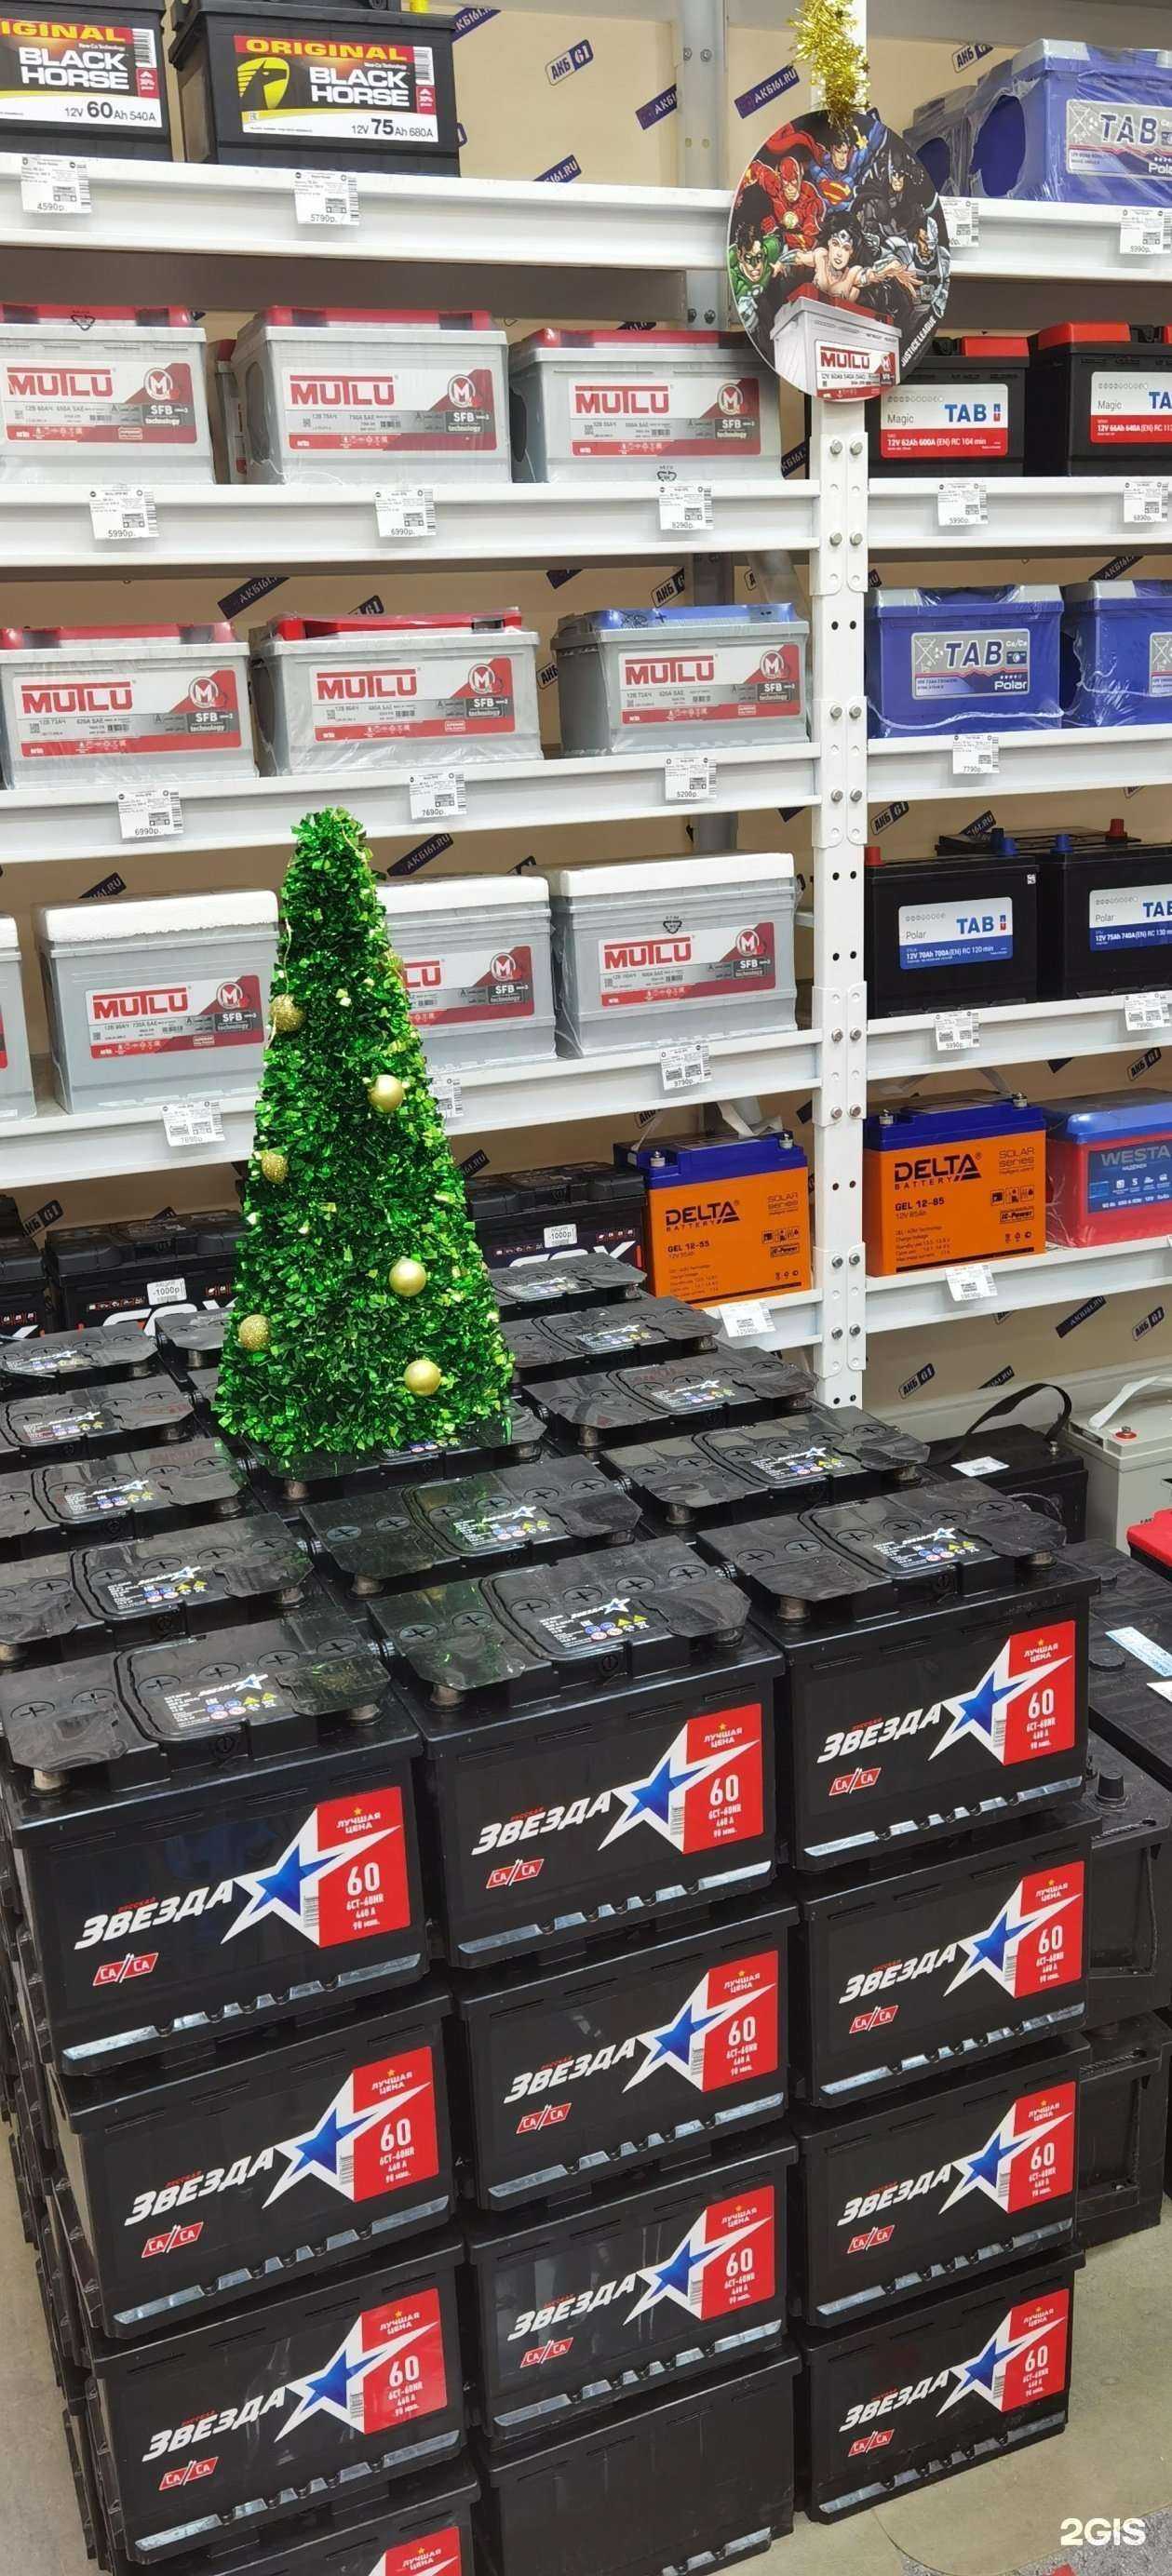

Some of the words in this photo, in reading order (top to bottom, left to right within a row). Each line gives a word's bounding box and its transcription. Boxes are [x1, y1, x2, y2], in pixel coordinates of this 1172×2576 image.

[19, 47, 128, 71] BLACK
[246, 39, 407, 60] ORIGINAL
[956, 45, 975, 68] АКБ
[20, 66, 129, 89] HORSE
[309, 67, 409, 88] BLACK
[550, 57, 572, 80] АКБ
[311, 85, 410, 107] HORSE
[753, 69, 799, 103] АКБ161.RU
[64, 107, 83, 117] 12V
[87, 101, 113, 118] 60
[114, 111, 128, 120] Ah
[130, 112, 156, 121] 540A
[352, 125, 369, 134] 12V
[371, 118, 394, 135] 75
[395, 127, 408, 136] Ah
[410, 127, 434, 137] 680A
[1099, 113, 1158, 144] TAB
[820, 346, 870, 369] MUTLU
[901, 338, 922, 368] JUSTICE
[7, 367, 114, 396] MUTLU
[290, 375, 396, 406] MUTLU
[575, 385, 669, 414] MUTLU
[1098, 400, 1123, 411] Magic
[151, 406, 173, 416] SFB
[453, 412, 475, 423] SFB
[887, 414, 914, 425] Magic
[945, 404, 987, 423] TAB
[722, 420, 742, 429] SFB
[945, 638, 1003, 669] TAB
[625, 656, 715, 686] MUTLU
[317, 669, 417, 701] MUTLU
[764, 683, 783, 692] SFB
[994, 680, 1028, 691] Polar
[20, 681, 133, 714] MUTLU
[473, 698, 494, 707] SFB
[195, 713, 219, 723] SFB
[406, 834, 451, 870] АКБ161.RU
[956, 916, 994, 935] TAB
[1096, 914, 1114, 922] Polar
[906, 931, 927, 940] Polar
[604, 936, 692, 970] MUTLU
[740, 959, 759, 968] SFB
[495, 986, 515, 994] SFB
[93, 986, 187, 1020] MUTLU
[222, 1013, 242, 1022] SFB
[999, 1147, 1034, 1160] SOLAR
[1101, 1145, 1171, 1167] WESTA
[895, 1153, 982, 1183] DELTA
[895, 1176, 952, 1191] BATTERY
[666, 1201, 739, 1226] DELTA
[896, 1201, 912, 1212] GEL
[916, 1197, 945, 1208] 12-85
[666, 1220, 715, 1232] BATTERY
[667, 1242, 683, 1253] GEL
[1024, 1643, 1058, 1657] ЛУЧШАЯ
[1030, 1651, 1052, 1663] ЦЕНА
[1028, 1688, 1054, 1719] 60
[704, 1727, 743, 1743] ЛУЧШАЯ
[710, 1736, 735, 1749] ЦЕНА
[816, 1702, 944, 1764] ЗВЕЗДА
[709, 1774, 739, 1805] 60
[337, 1812, 381, 1829] ЛУЧШАЯ
[345, 1821, 372, 1834] ЦЕНА
[471, 1791, 613, 1856] ЗВЕЗДА
[347, 1862, 380, 1896] 60
[1035, 1883, 1069, 1898] ЛУЧШАЯ
[1041, 1891, 1062, 1902] ЦЕНА
[74, 1879, 236, 1951] ЗВЕЗДА
[1038, 1925, 1063, 1954] 60
[723, 1972, 761, 1990] ЛУЧШАЯ
[839, 1943, 959, 2005] ЗВЕЗДА
[730, 1980, 753, 1993] ЦЕНА
[728, 2016, 756, 2046] 60
[503, 2035, 638, 2105] ЗВЕЗДА
[371, 2072, 413, 2091] ЛУЧШАЯ
[379, 2081, 405, 2095] ЦЕНА
[1028, 2102, 1060, 2119] ЛУЧШАЯ
[1033, 2110, 1054, 2122] ЦЕНА
[380, 2117, 411, 2153] 60
[1031, 2142, 1056, 2170] 60
[124, 2147, 276, 2227] ЗВЕЗДА
[837, 2164, 953, 2226] ЗВЕЗДА
[721, 2207, 758, 2224] ЛУЧШАЯ
[727, 2215, 751, 2228] ЦЕНА
[725, 2247, 753, 2278] 60
[507, 2272, 638, 2341] ЗВЕЗДА
[1023, 2308, 1055, 2325] ЛУЧШАЯ
[380, 2312, 421, 2331] ЛУЧШАЯ
[387, 2321, 412, 2335] ЦЕНА
[1029, 2316, 1048, 2328] ЦЕНА
[1025, 2345, 1048, 2373] 60
[388, 2355, 420, 2388] 60
[839, 2369, 952, 2433] ЗВЕЗДА
[141, 2386, 286, 2462] ЗВЕЗДА
[402, 2548, 442, 2569] ЛУЧШАЯ
[410, 2556, 435, 2571] ЦЕНА
